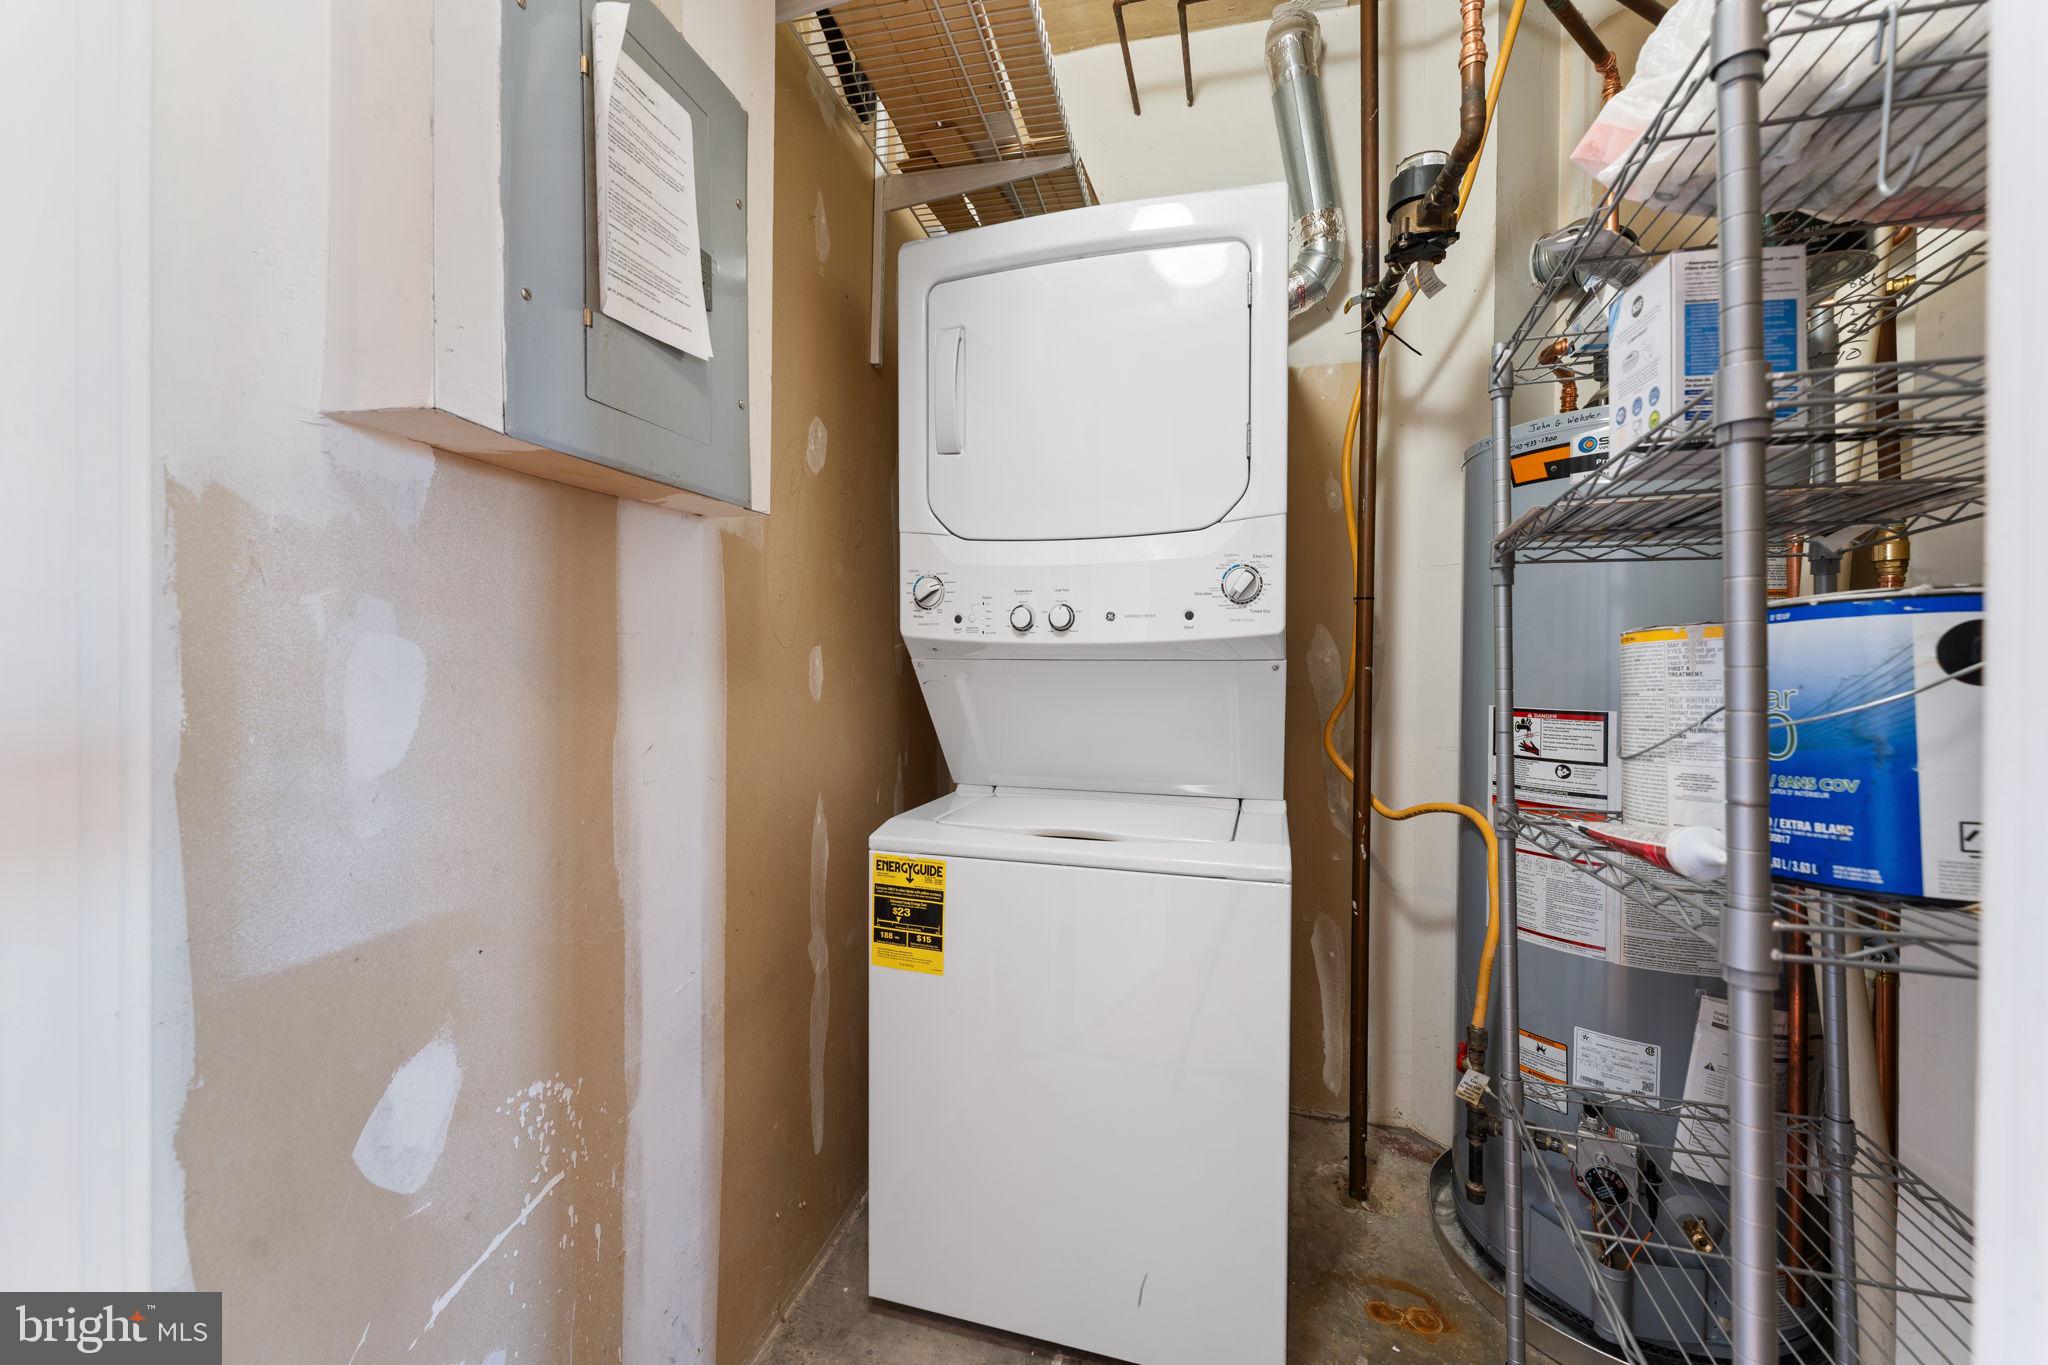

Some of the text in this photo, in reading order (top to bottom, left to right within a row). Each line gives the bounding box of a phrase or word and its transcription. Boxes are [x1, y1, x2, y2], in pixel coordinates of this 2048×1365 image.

[1528, 423, 1551, 433] John
[1567, 411, 1602, 424] Webster
[1778, 774, 1817, 791] SANS
[1819, 777, 1862, 793] COV
[1779, 818, 1812, 832] EXTRA
[1814, 822, 1855, 836] BLANC
[876, 859, 943, 877] ENERGYGUIDE
[892, 906, 911, 917] $23
[879, 931, 894, 940] 188
[916, 934, 932, 944] $15
